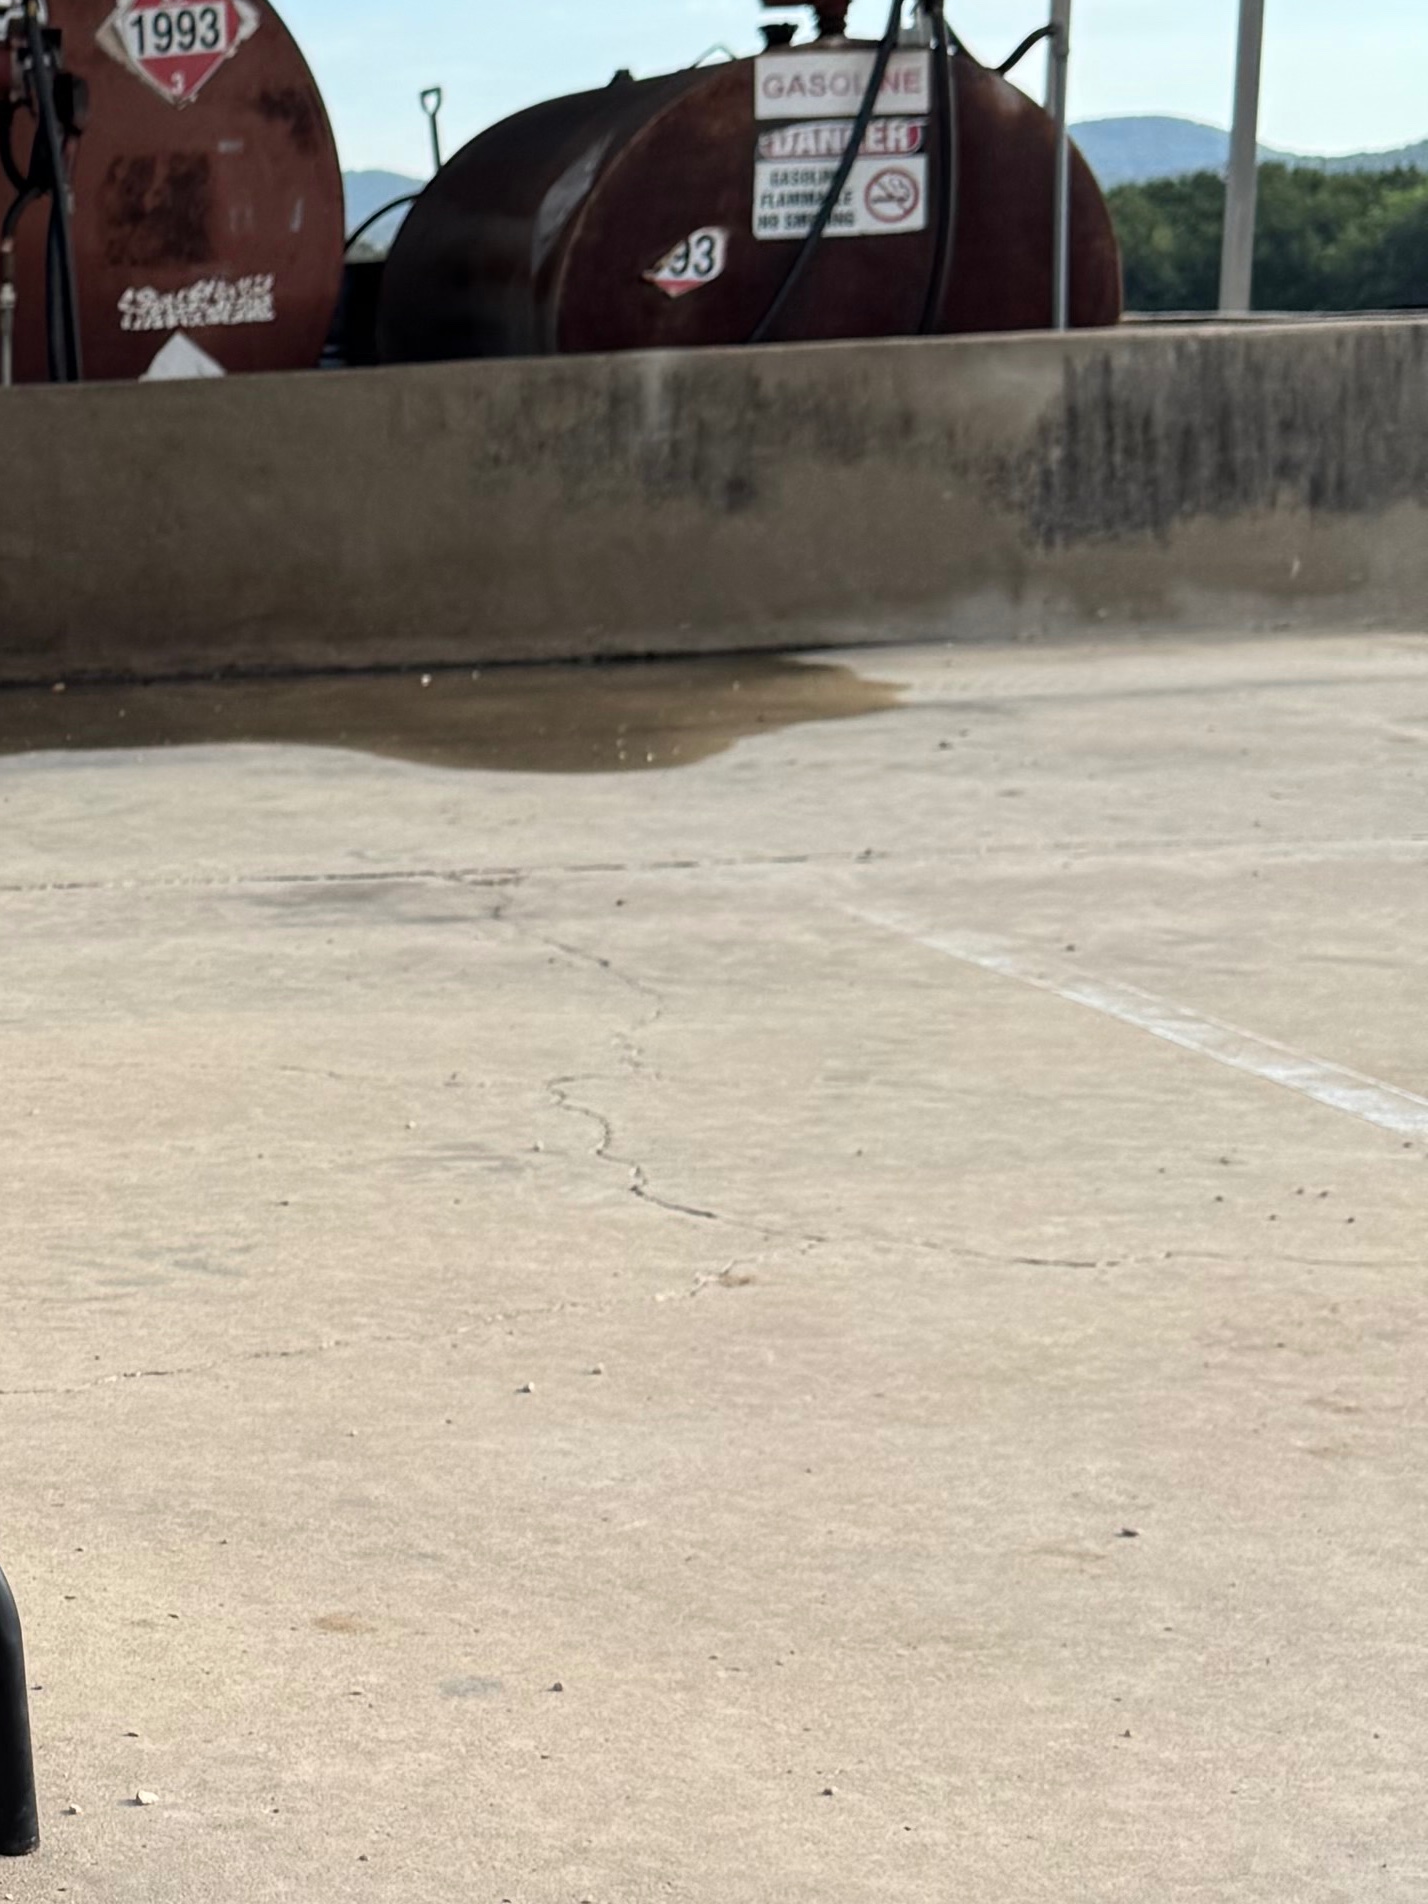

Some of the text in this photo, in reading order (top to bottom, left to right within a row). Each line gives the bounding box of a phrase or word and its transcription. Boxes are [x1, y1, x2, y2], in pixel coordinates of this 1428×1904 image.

[130, 7, 220, 56] 1993
[170, 72, 185, 95] 3
[762, 67, 922, 99] GASOLNE
[770, 118, 910, 157] DANER
